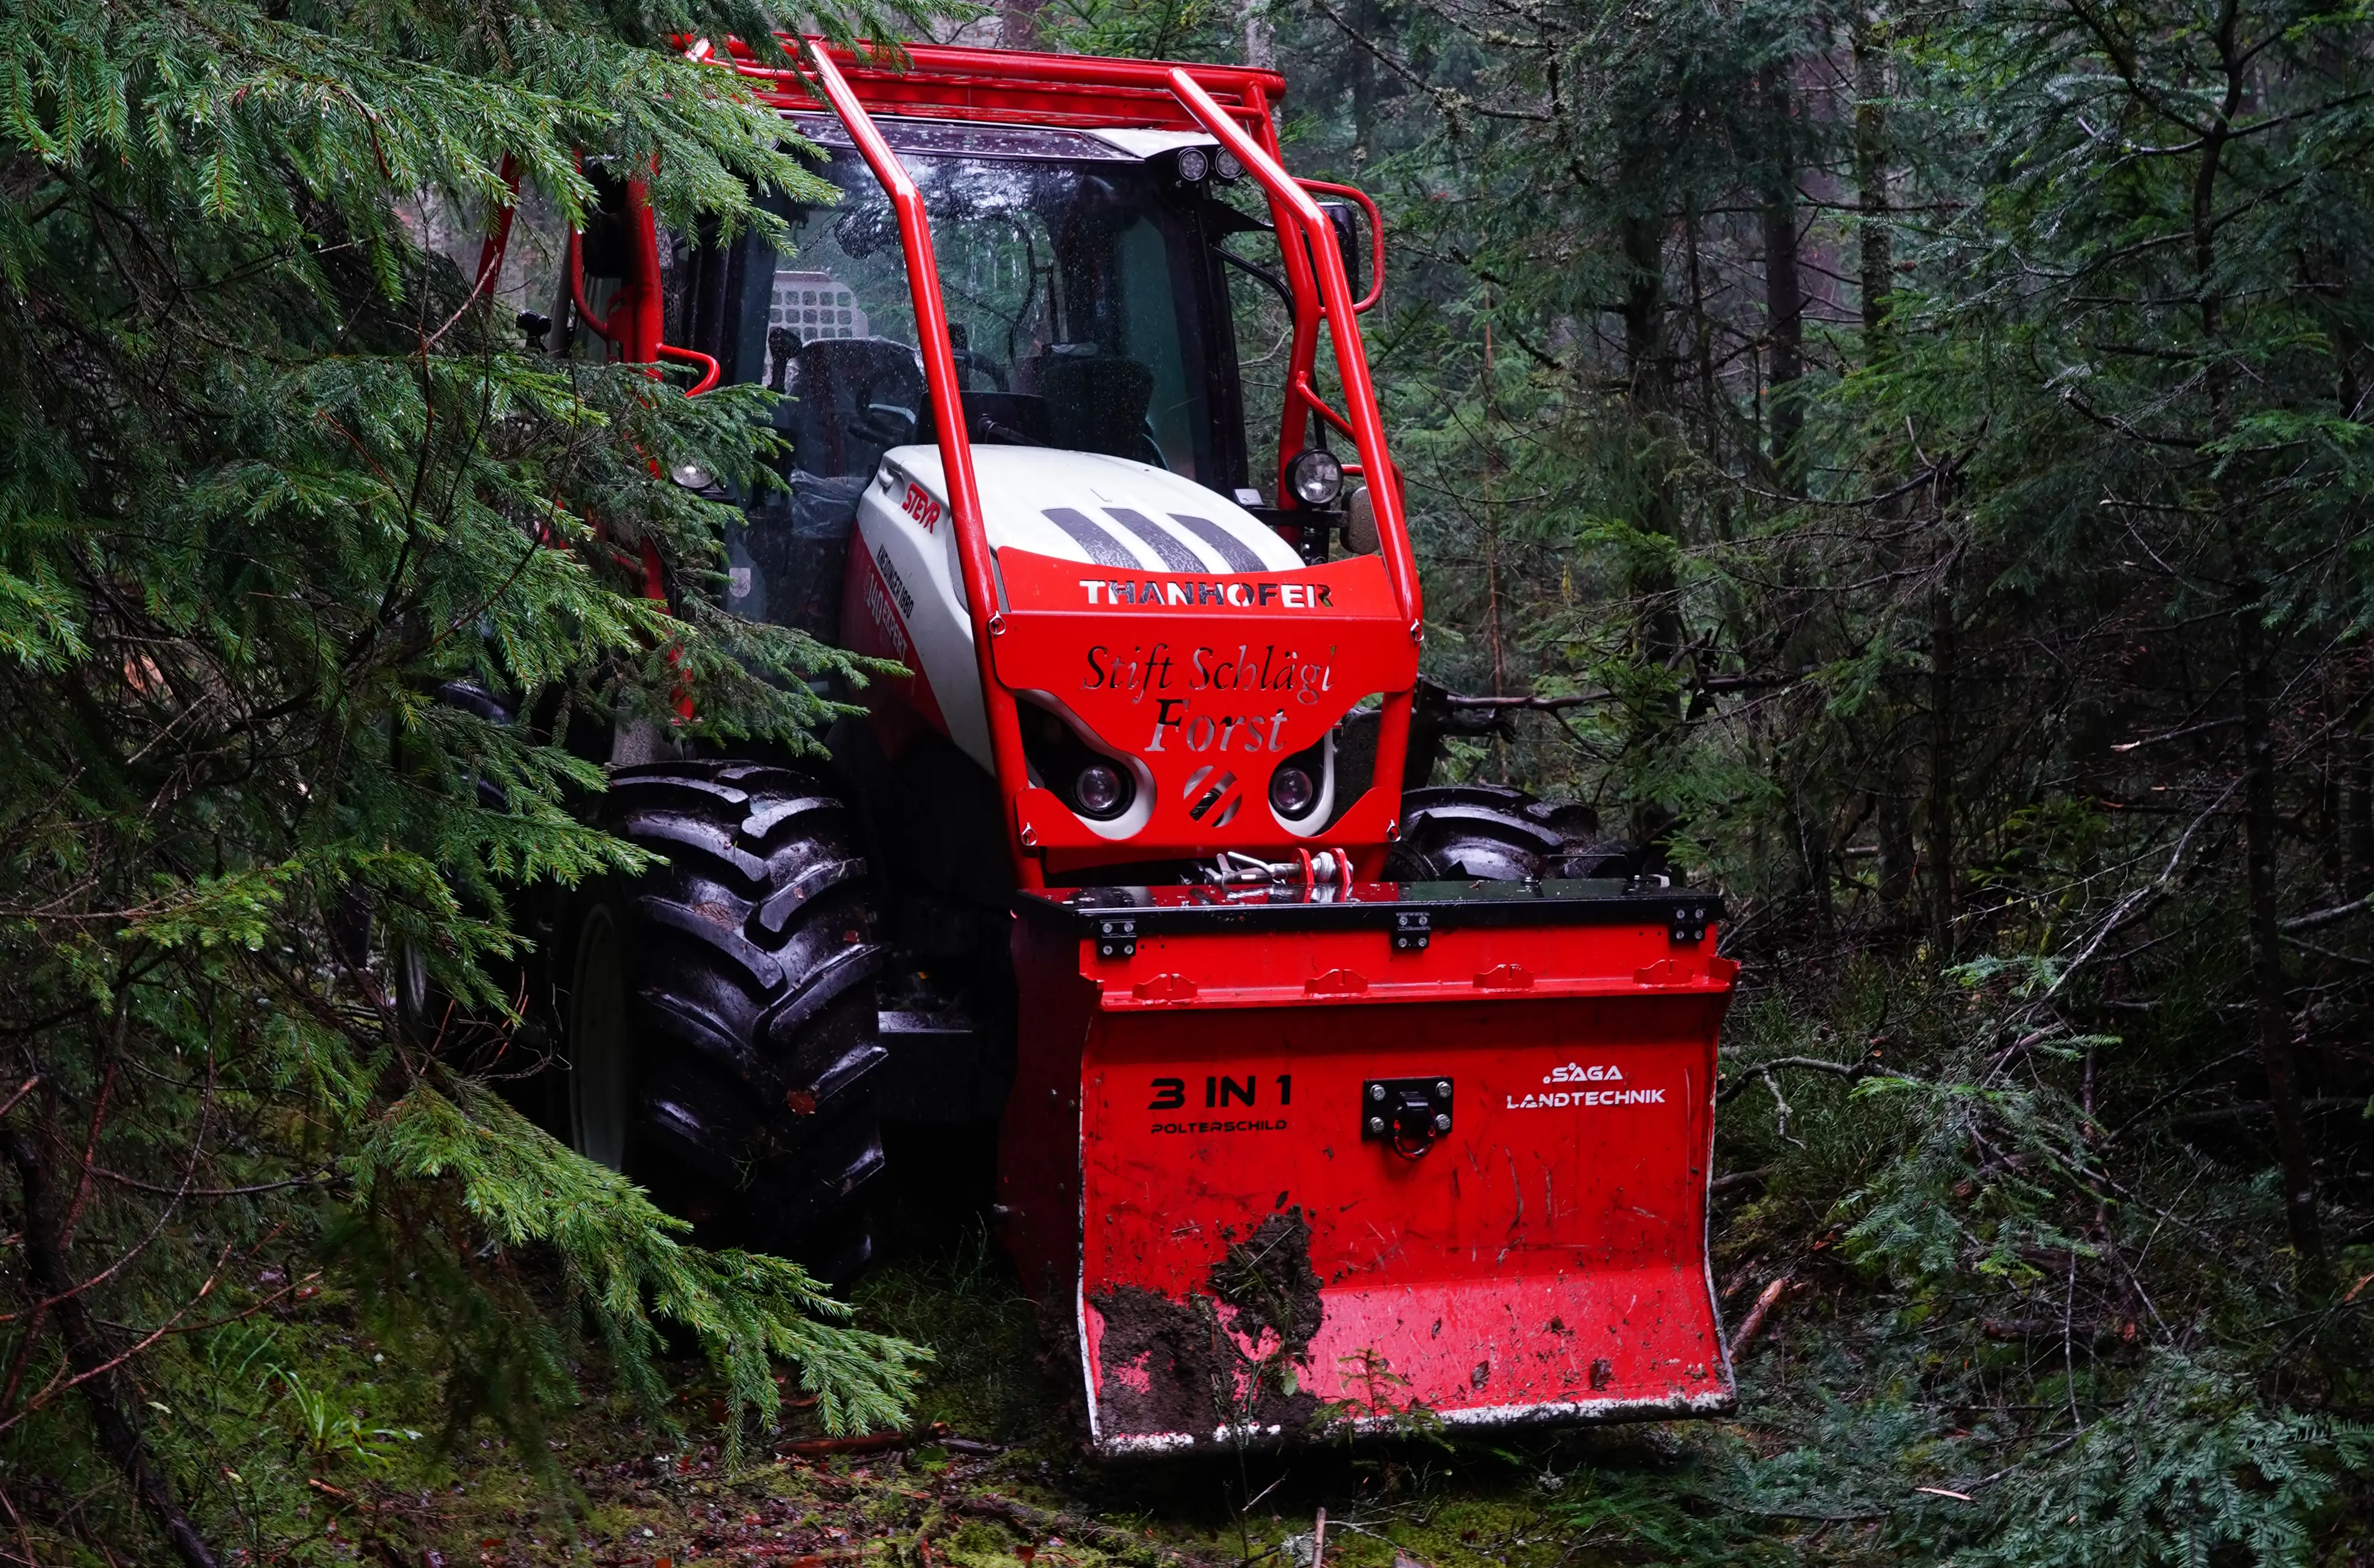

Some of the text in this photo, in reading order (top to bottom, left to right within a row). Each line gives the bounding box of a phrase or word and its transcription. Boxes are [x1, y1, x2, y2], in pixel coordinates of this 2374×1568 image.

[902, 482, 940, 534] STEYR
[876, 543, 914, 619] KNEIDINGER 1880
[1079, 579, 1334, 608] THANHOFER
[882, 603, 908, 662] EXPERT
[1082, 643, 1337, 706] Stift Schlägl
[1144, 698, 1289, 752] Forst
[1148, 1075, 1292, 1110] 3 IN 1
[1507, 1088, 1666, 1109] LANDTECHNIK
[1150, 1119, 1287, 1135] POLTERSCHILD
